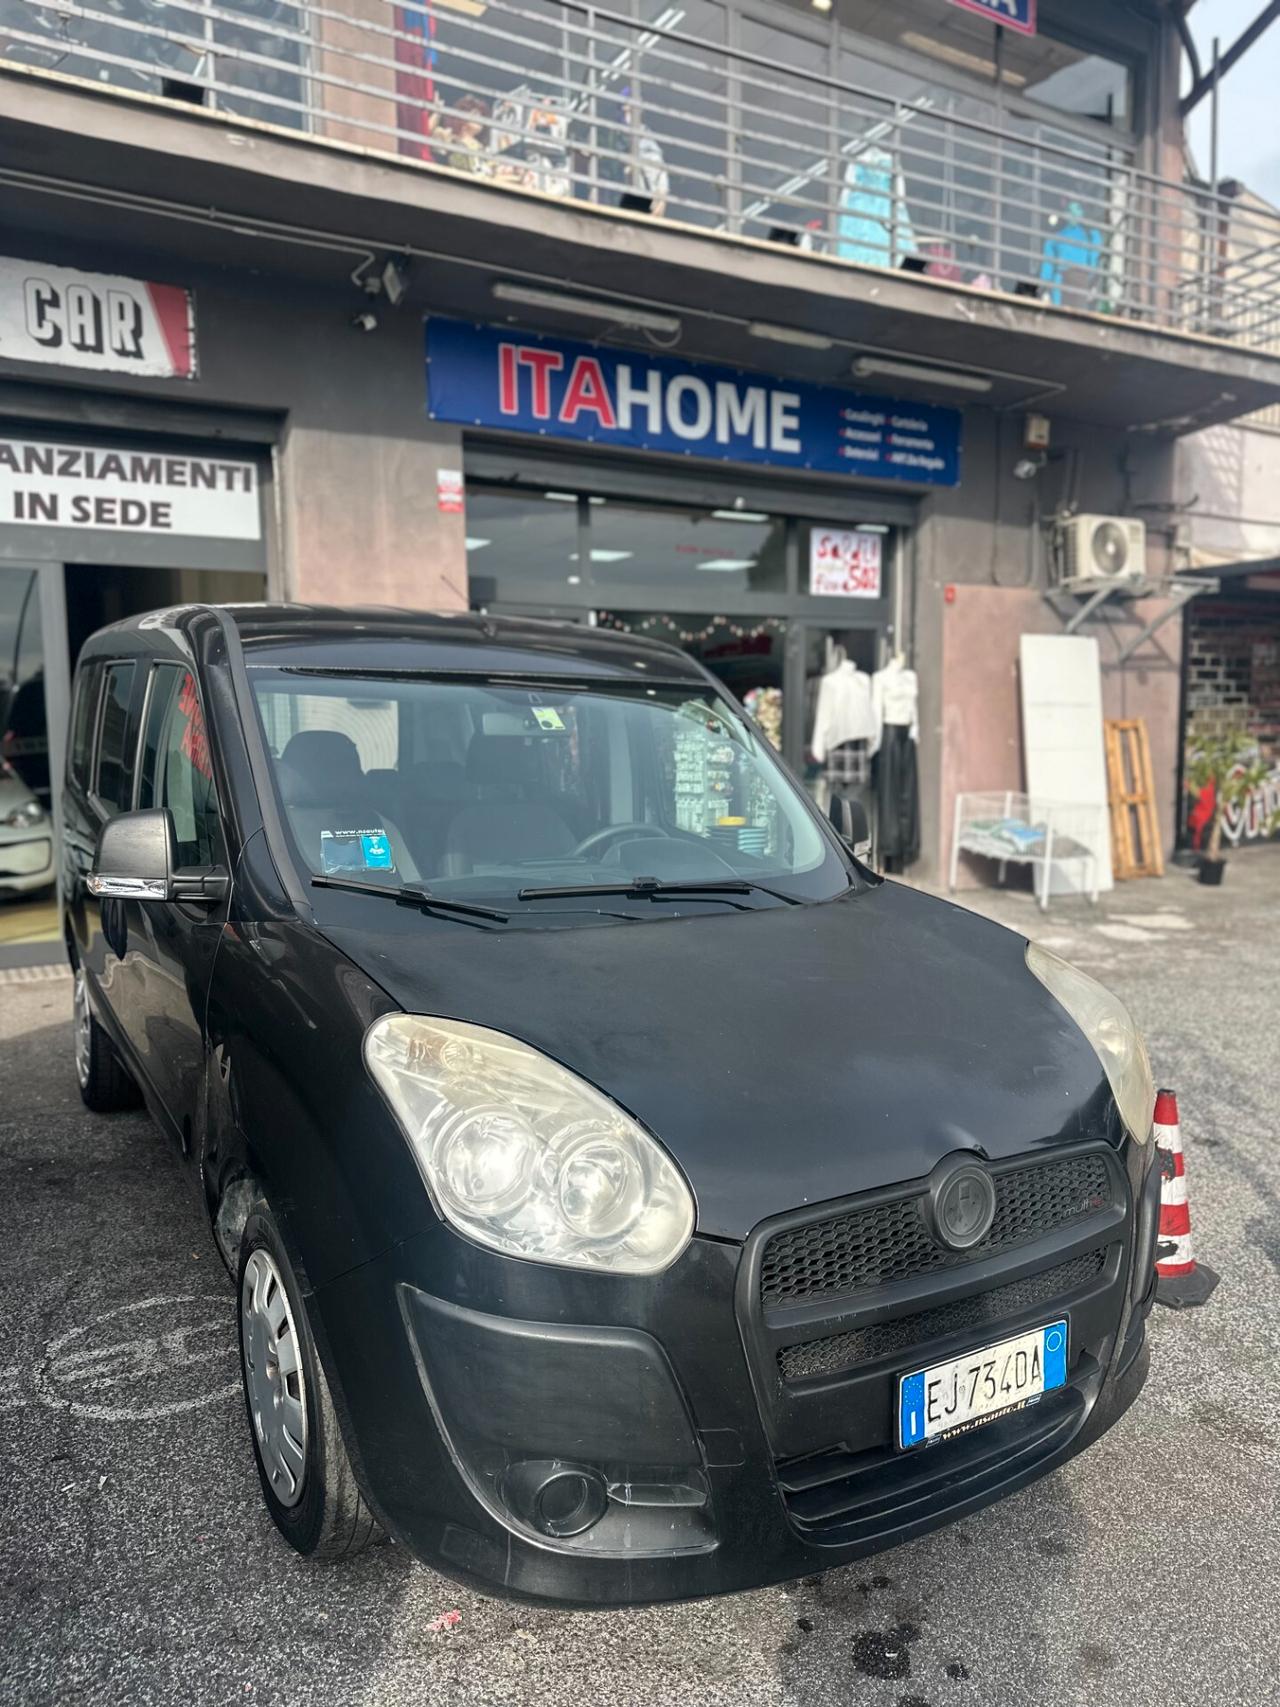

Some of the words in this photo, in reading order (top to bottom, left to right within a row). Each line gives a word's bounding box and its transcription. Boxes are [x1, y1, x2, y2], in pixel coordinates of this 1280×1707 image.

[24, 277, 144, 360] CAR
[499, 343, 801, 453] ITAHOME
[13, 491, 59, 521] IN
[70, 495, 173, 529] SEDE
